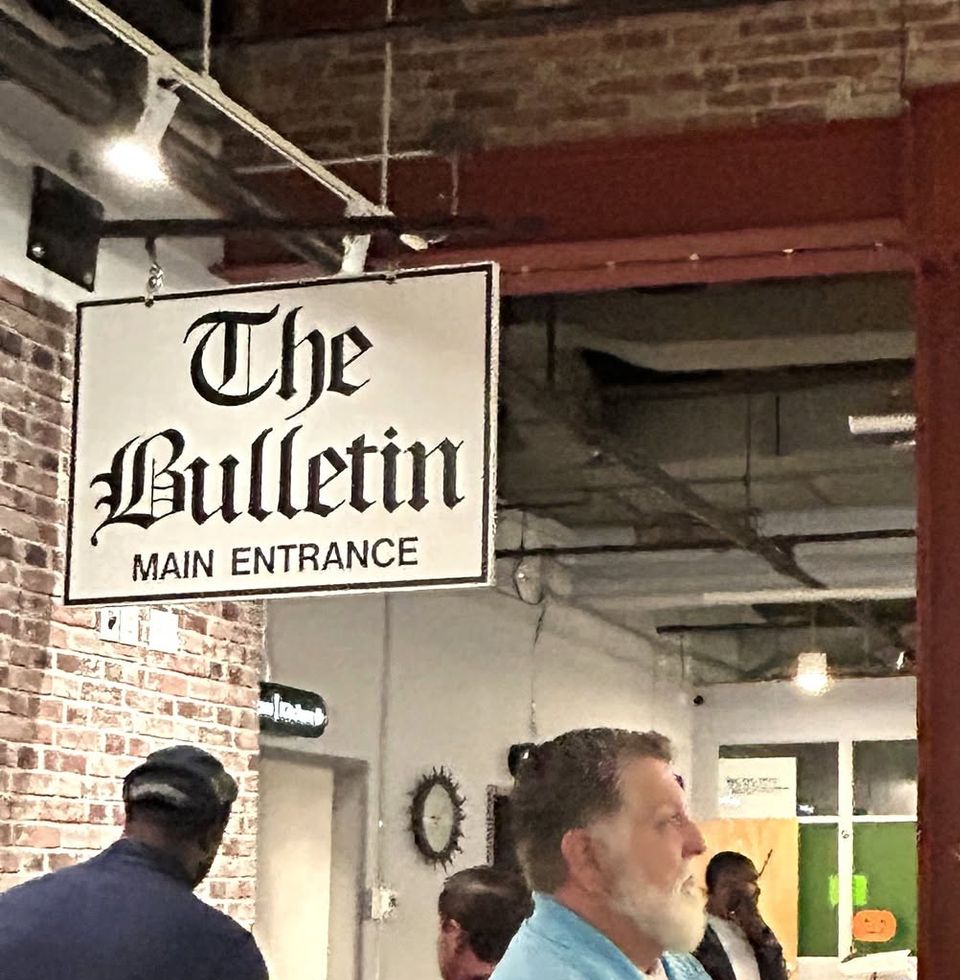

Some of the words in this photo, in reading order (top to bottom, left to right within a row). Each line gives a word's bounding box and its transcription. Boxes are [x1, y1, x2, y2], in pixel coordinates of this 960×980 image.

[183, 304, 373, 421] The
[90, 425, 465, 547] Bulletin
[133, 549, 214, 582] MAIN
[232, 537, 418, 576] ENTRANCE
